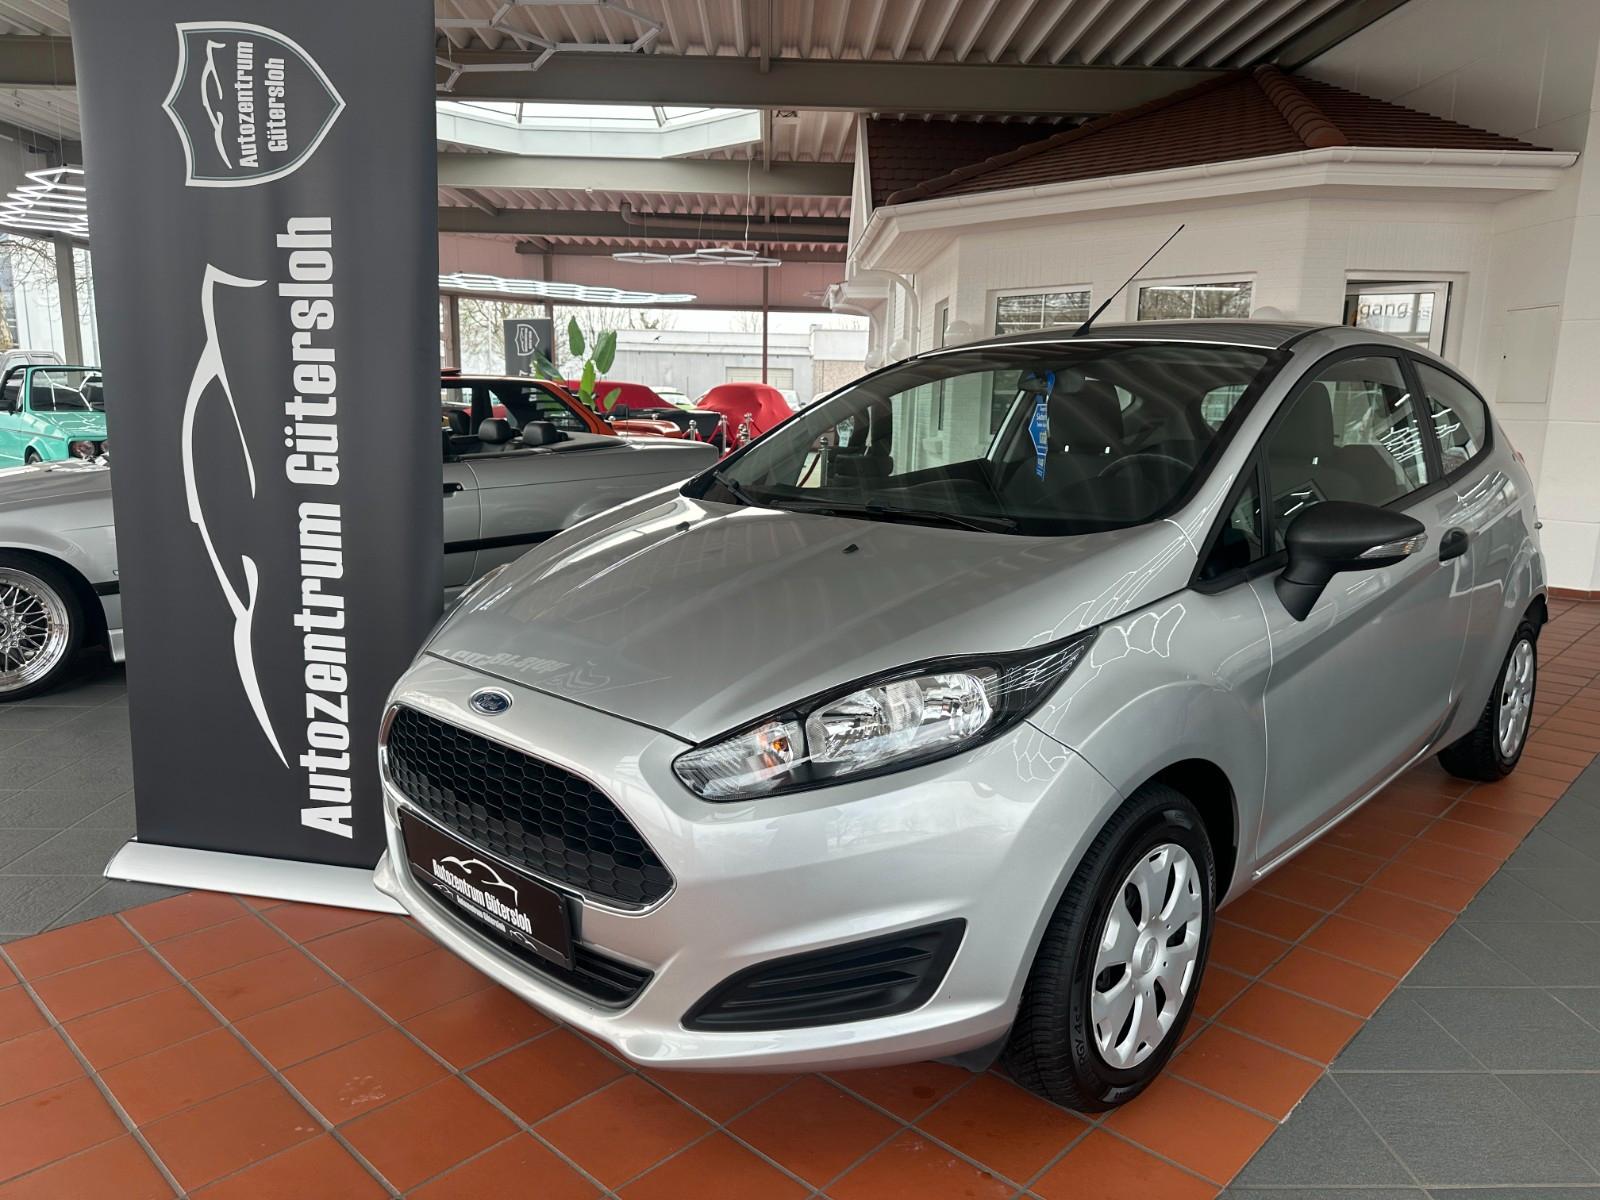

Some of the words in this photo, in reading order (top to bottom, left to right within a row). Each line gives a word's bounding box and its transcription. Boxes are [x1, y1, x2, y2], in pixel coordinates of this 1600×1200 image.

[235, 41, 259, 168] Autozentrum
[264, 57, 288, 152] Gütersloh
[276, 216, 340, 486] Gütersloh
[293, 501, 353, 840] Autozentrum
[432, 858, 486, 908] Autozentrum
[484, 891, 533, 935] Gütersloh
